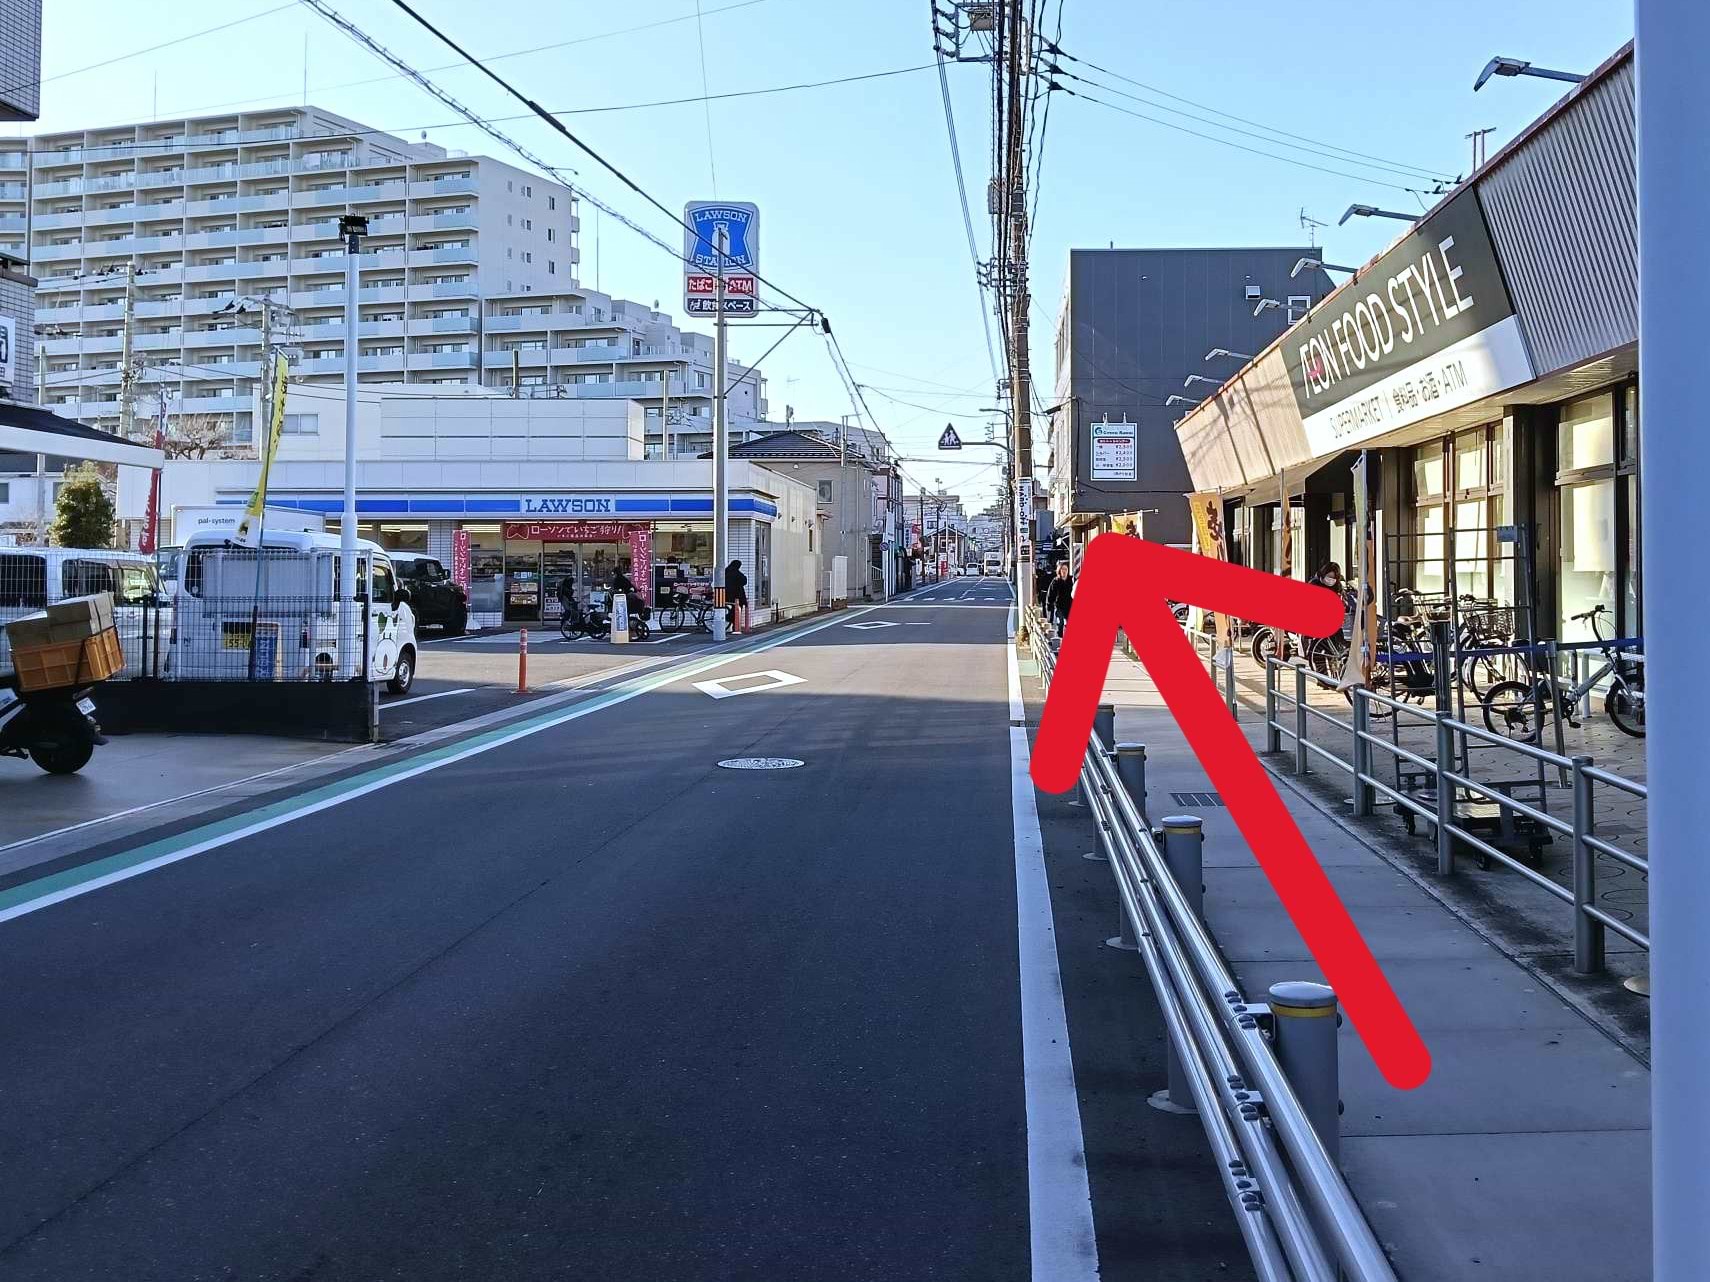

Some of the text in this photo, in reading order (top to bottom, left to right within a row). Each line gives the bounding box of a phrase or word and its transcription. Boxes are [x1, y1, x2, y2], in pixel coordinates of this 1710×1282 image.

[695, 210, 748, 223] LAWSON
[688, 278, 713, 291] たばこ
[728, 279, 753, 292] ATM
[1331, 292, 1394, 376] FOOD
[1388, 235, 1473, 343] STYLE
[1329, 396, 1385, 439] SUPERMARKET
[525, 498, 611, 513] LAWSON
